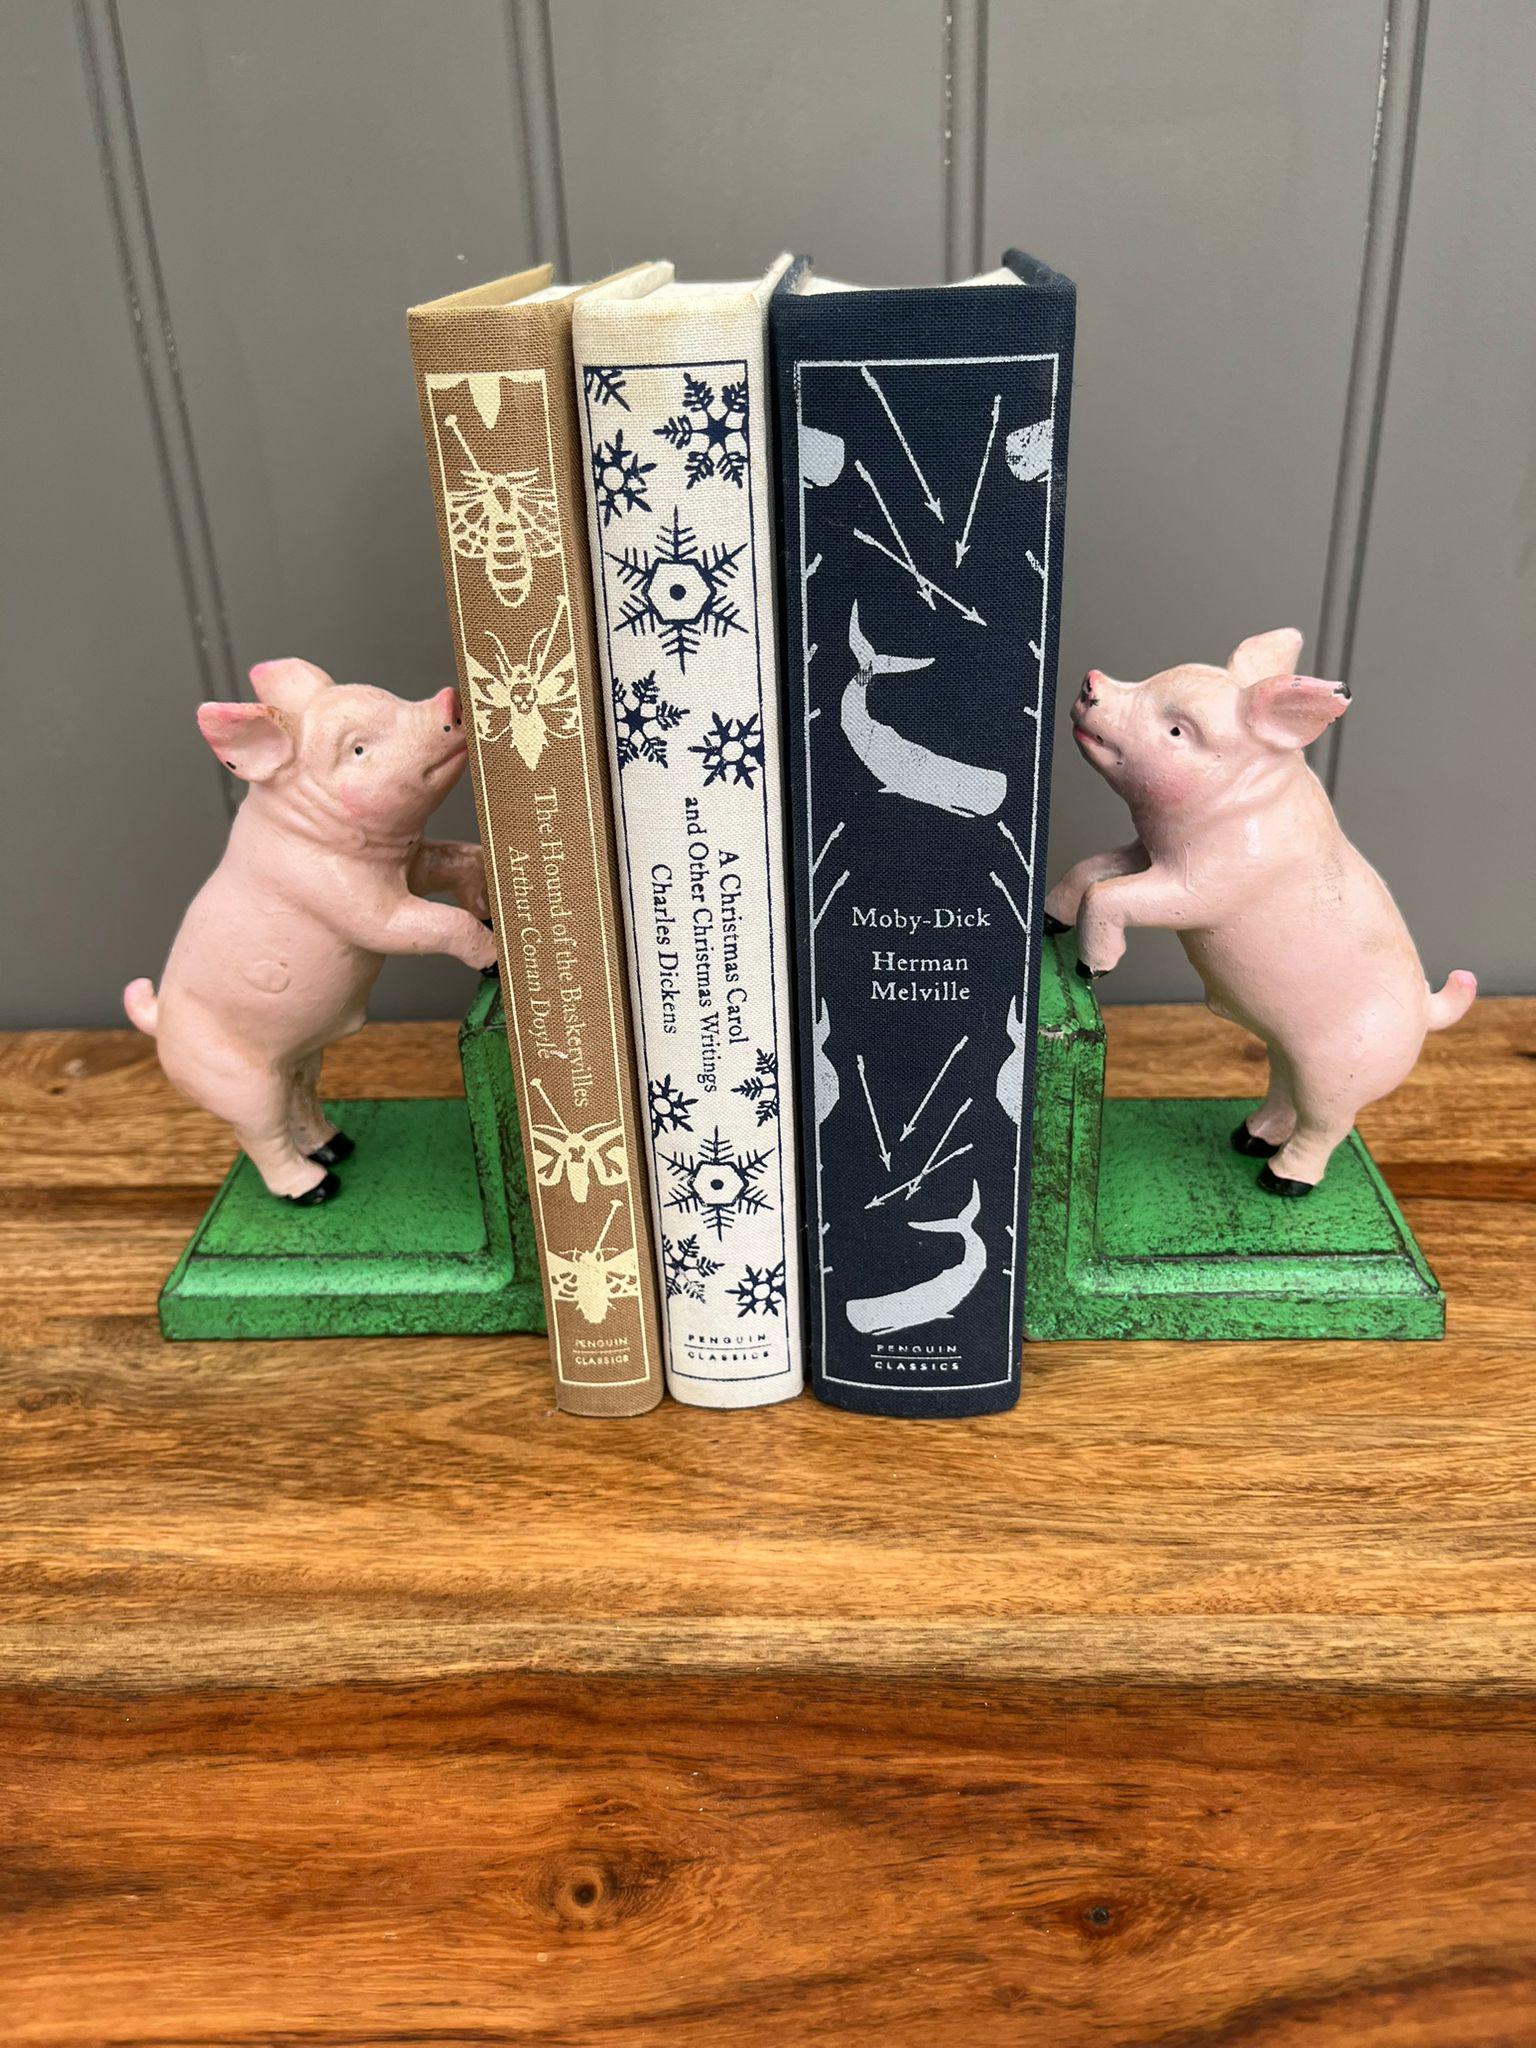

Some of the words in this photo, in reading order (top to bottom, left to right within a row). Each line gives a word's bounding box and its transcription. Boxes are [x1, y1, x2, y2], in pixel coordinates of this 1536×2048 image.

[534, 786, 559, 834] The
[684, 797, 708, 836] and
[508, 846, 534, 921] Arthur
[540, 838, 572, 919] Hound
[688, 841, 710, 903] Other
[718, 849, 740, 868] A
[651, 864, 676, 945] Charles
[719, 873, 743, 983] Christmas
[851, 906, 991, 934] Moby-Dick
[520, 927, 543, 992] Conan
[552, 923, 577, 947] of
[692, 908, 715, 1008] Christmas
[871, 951, 969, 972] Herman
[555, 951, 578, 981] the
[658, 951, 681, 1034] Dickens
[870, 980, 971, 1001] Melville
[528, 997, 558, 1059] Doyle
[726, 987, 750, 1044] Carol
[560, 985, 594, 1108] Baskervilles
[697, 1011, 722, 1093] Writings
[688, 1333, 766, 1344] PENGUIN
[874, 1361, 959, 1371] CLASSICS
[876, 1344, 957, 1354] PENGUIN
